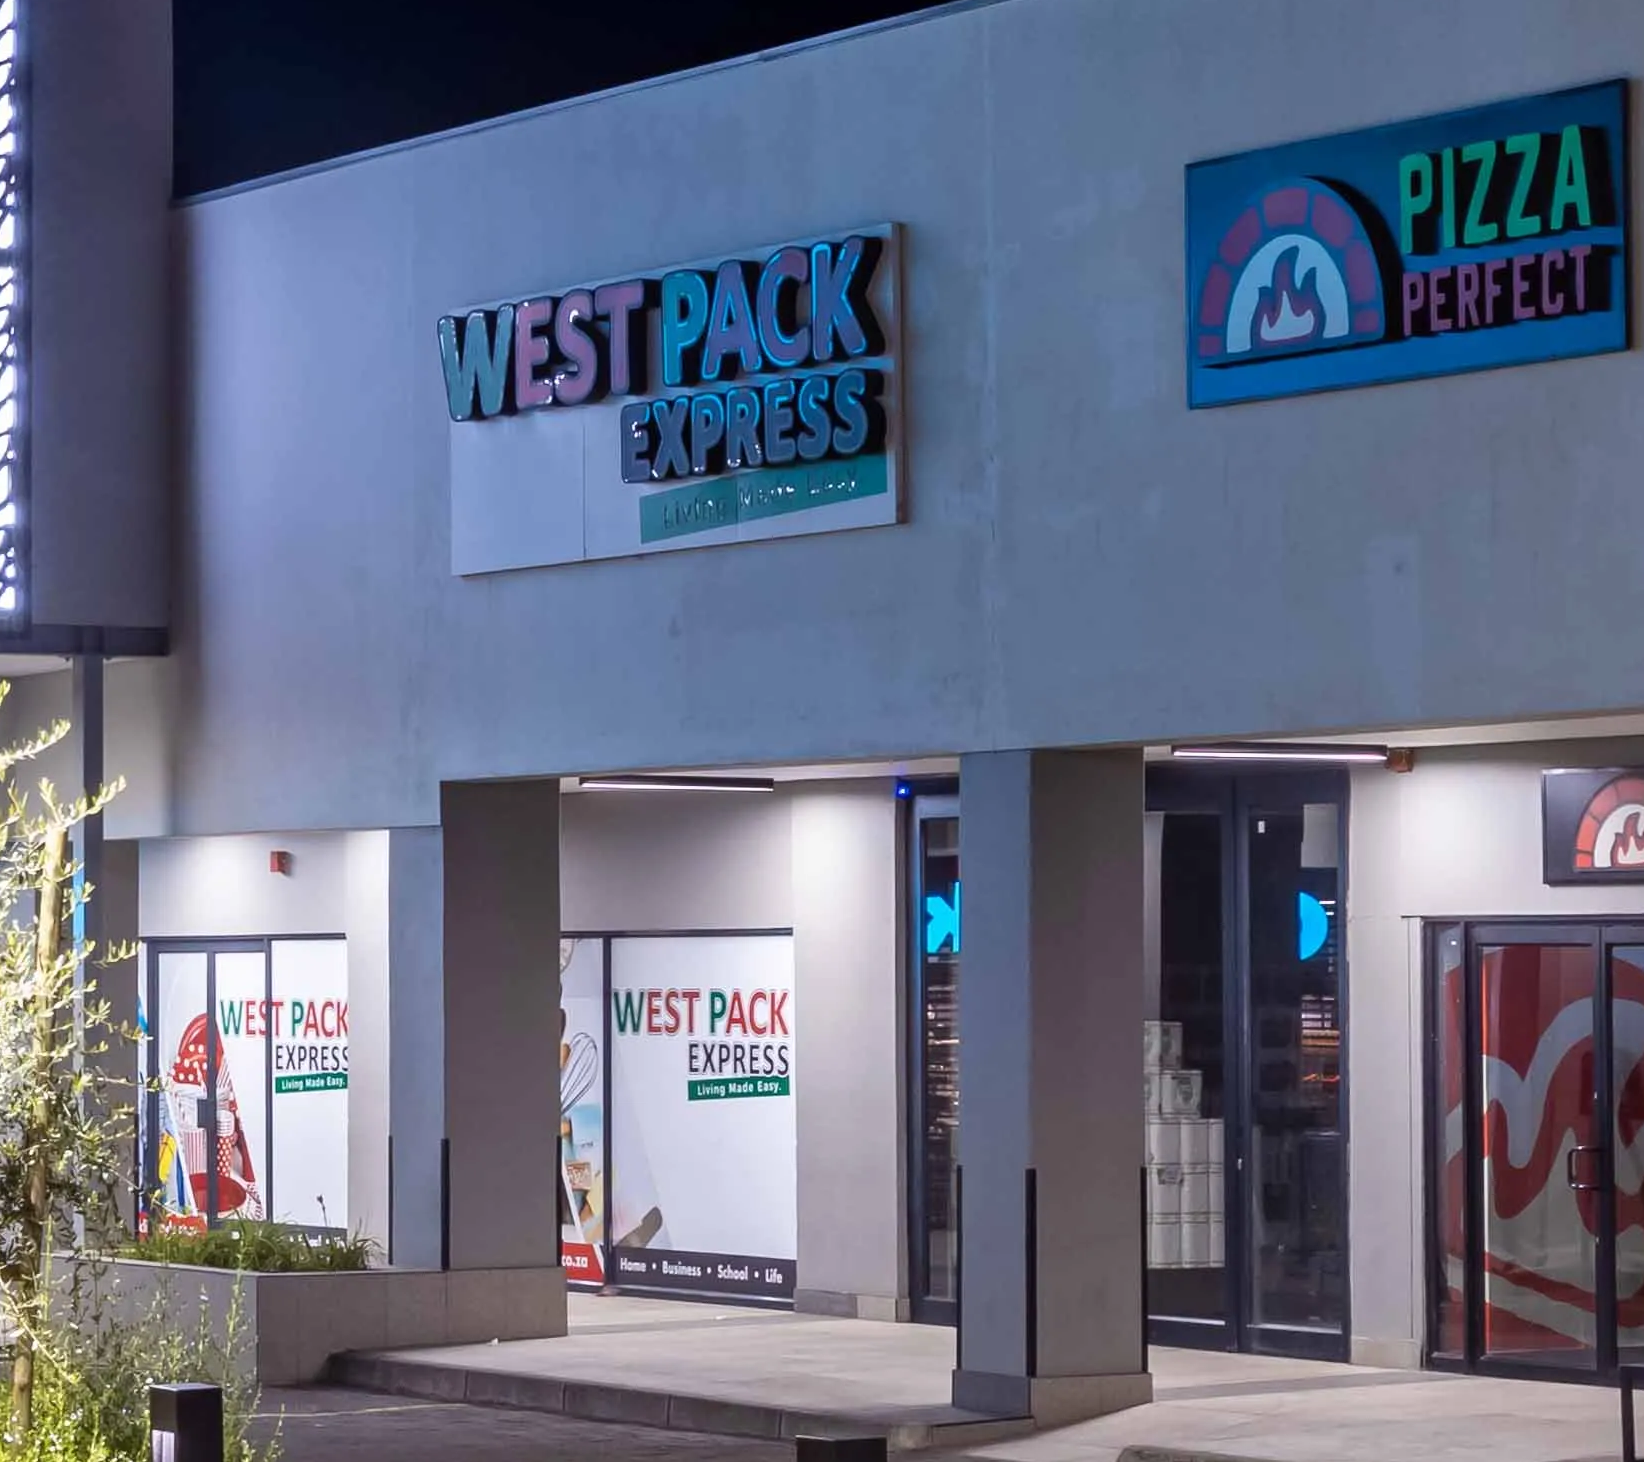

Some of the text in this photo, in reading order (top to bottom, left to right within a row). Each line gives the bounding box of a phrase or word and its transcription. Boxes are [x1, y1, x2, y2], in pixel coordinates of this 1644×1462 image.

[1399, 124, 1592, 254] PIZZA
[1402, 244, 1592, 337] PERFECT
[437, 235, 870, 422] WEST PACK
[621, 368, 870, 484] EXPRESS
[662, 497, 727, 530] Living
[220, 999, 348, 1038] WEST PACK
[613, 991, 789, 1036] WEST PACK
[275, 1044, 348, 1072] EXPRESS
[688, 1042, 789, 1076] EXPRESS
[281, 1079, 304, 1091] Living
[305, 1077, 325, 1088] Made
[697, 1080, 782, 1098] Living Made Easy.
[561, 1254, 589, 1269] co.za
[620, 1257, 783, 1284] Home Business School Life
